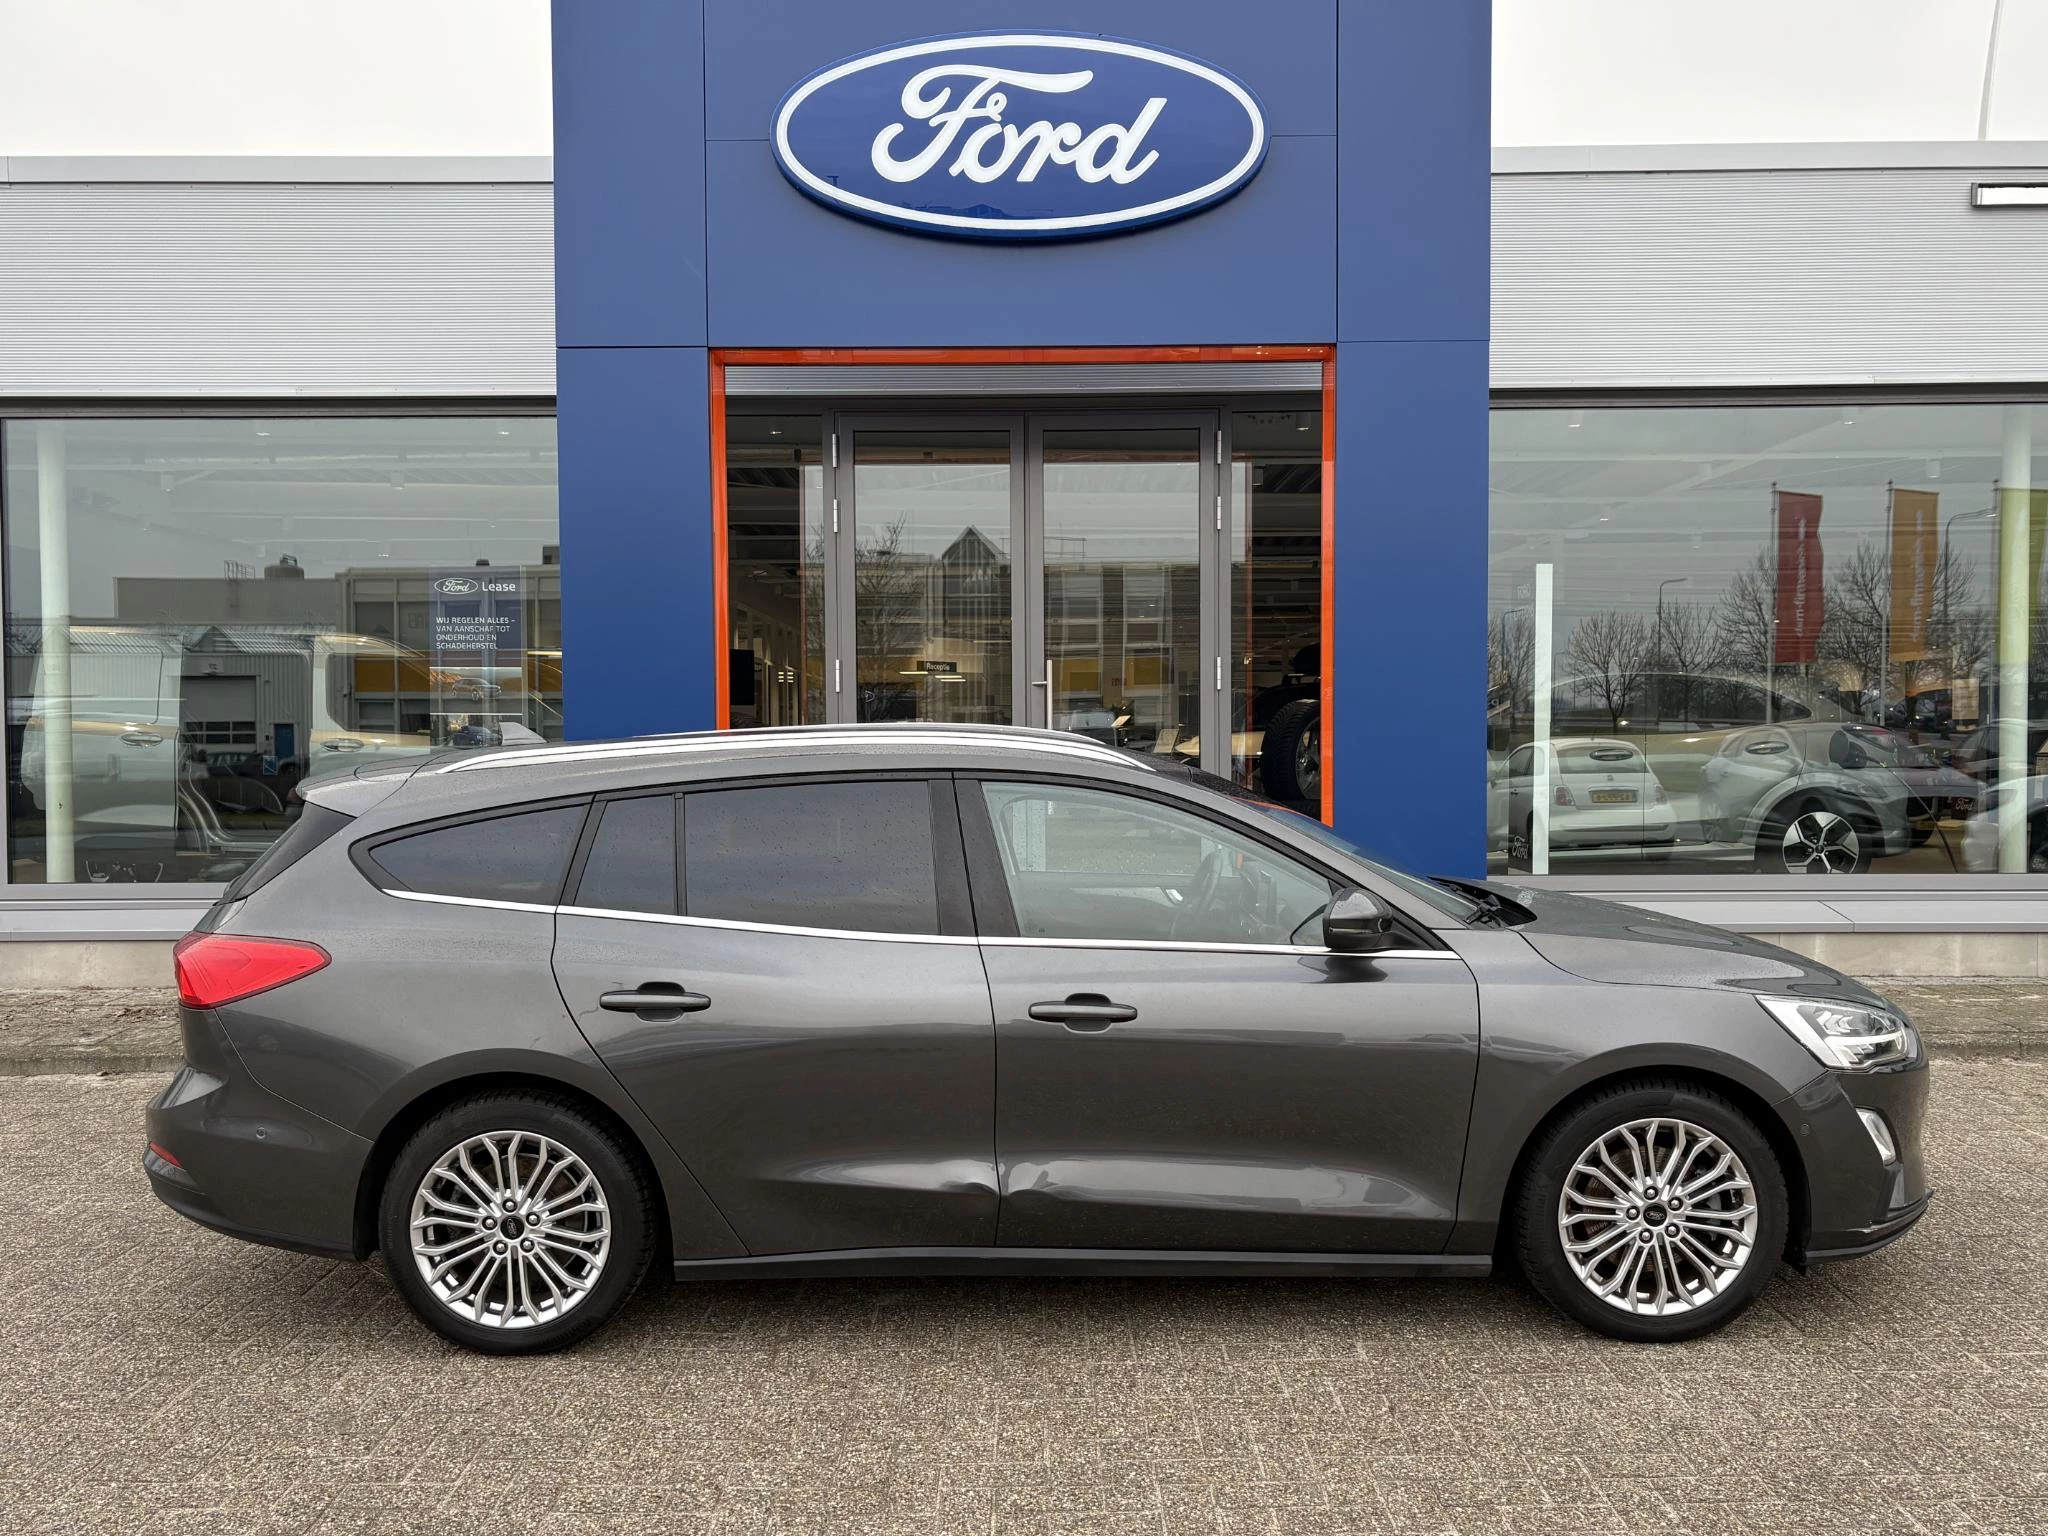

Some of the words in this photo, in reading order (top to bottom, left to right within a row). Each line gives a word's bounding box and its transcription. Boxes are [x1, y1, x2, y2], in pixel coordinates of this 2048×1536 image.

[871, 64, 1168, 184] Ford
[442, 579, 470, 592] Ford
[482, 581, 516, 592] Lease
[436, 625, 453, 633] VAN
[454, 625, 494, 633] AANSCHAF
[495, 625, 511, 633] TOT
[436, 642, 498, 650] SCHADEHERSTEL
[1955, 797, 1974, 811] Ford
[1511, 835, 1530, 860] Ford
